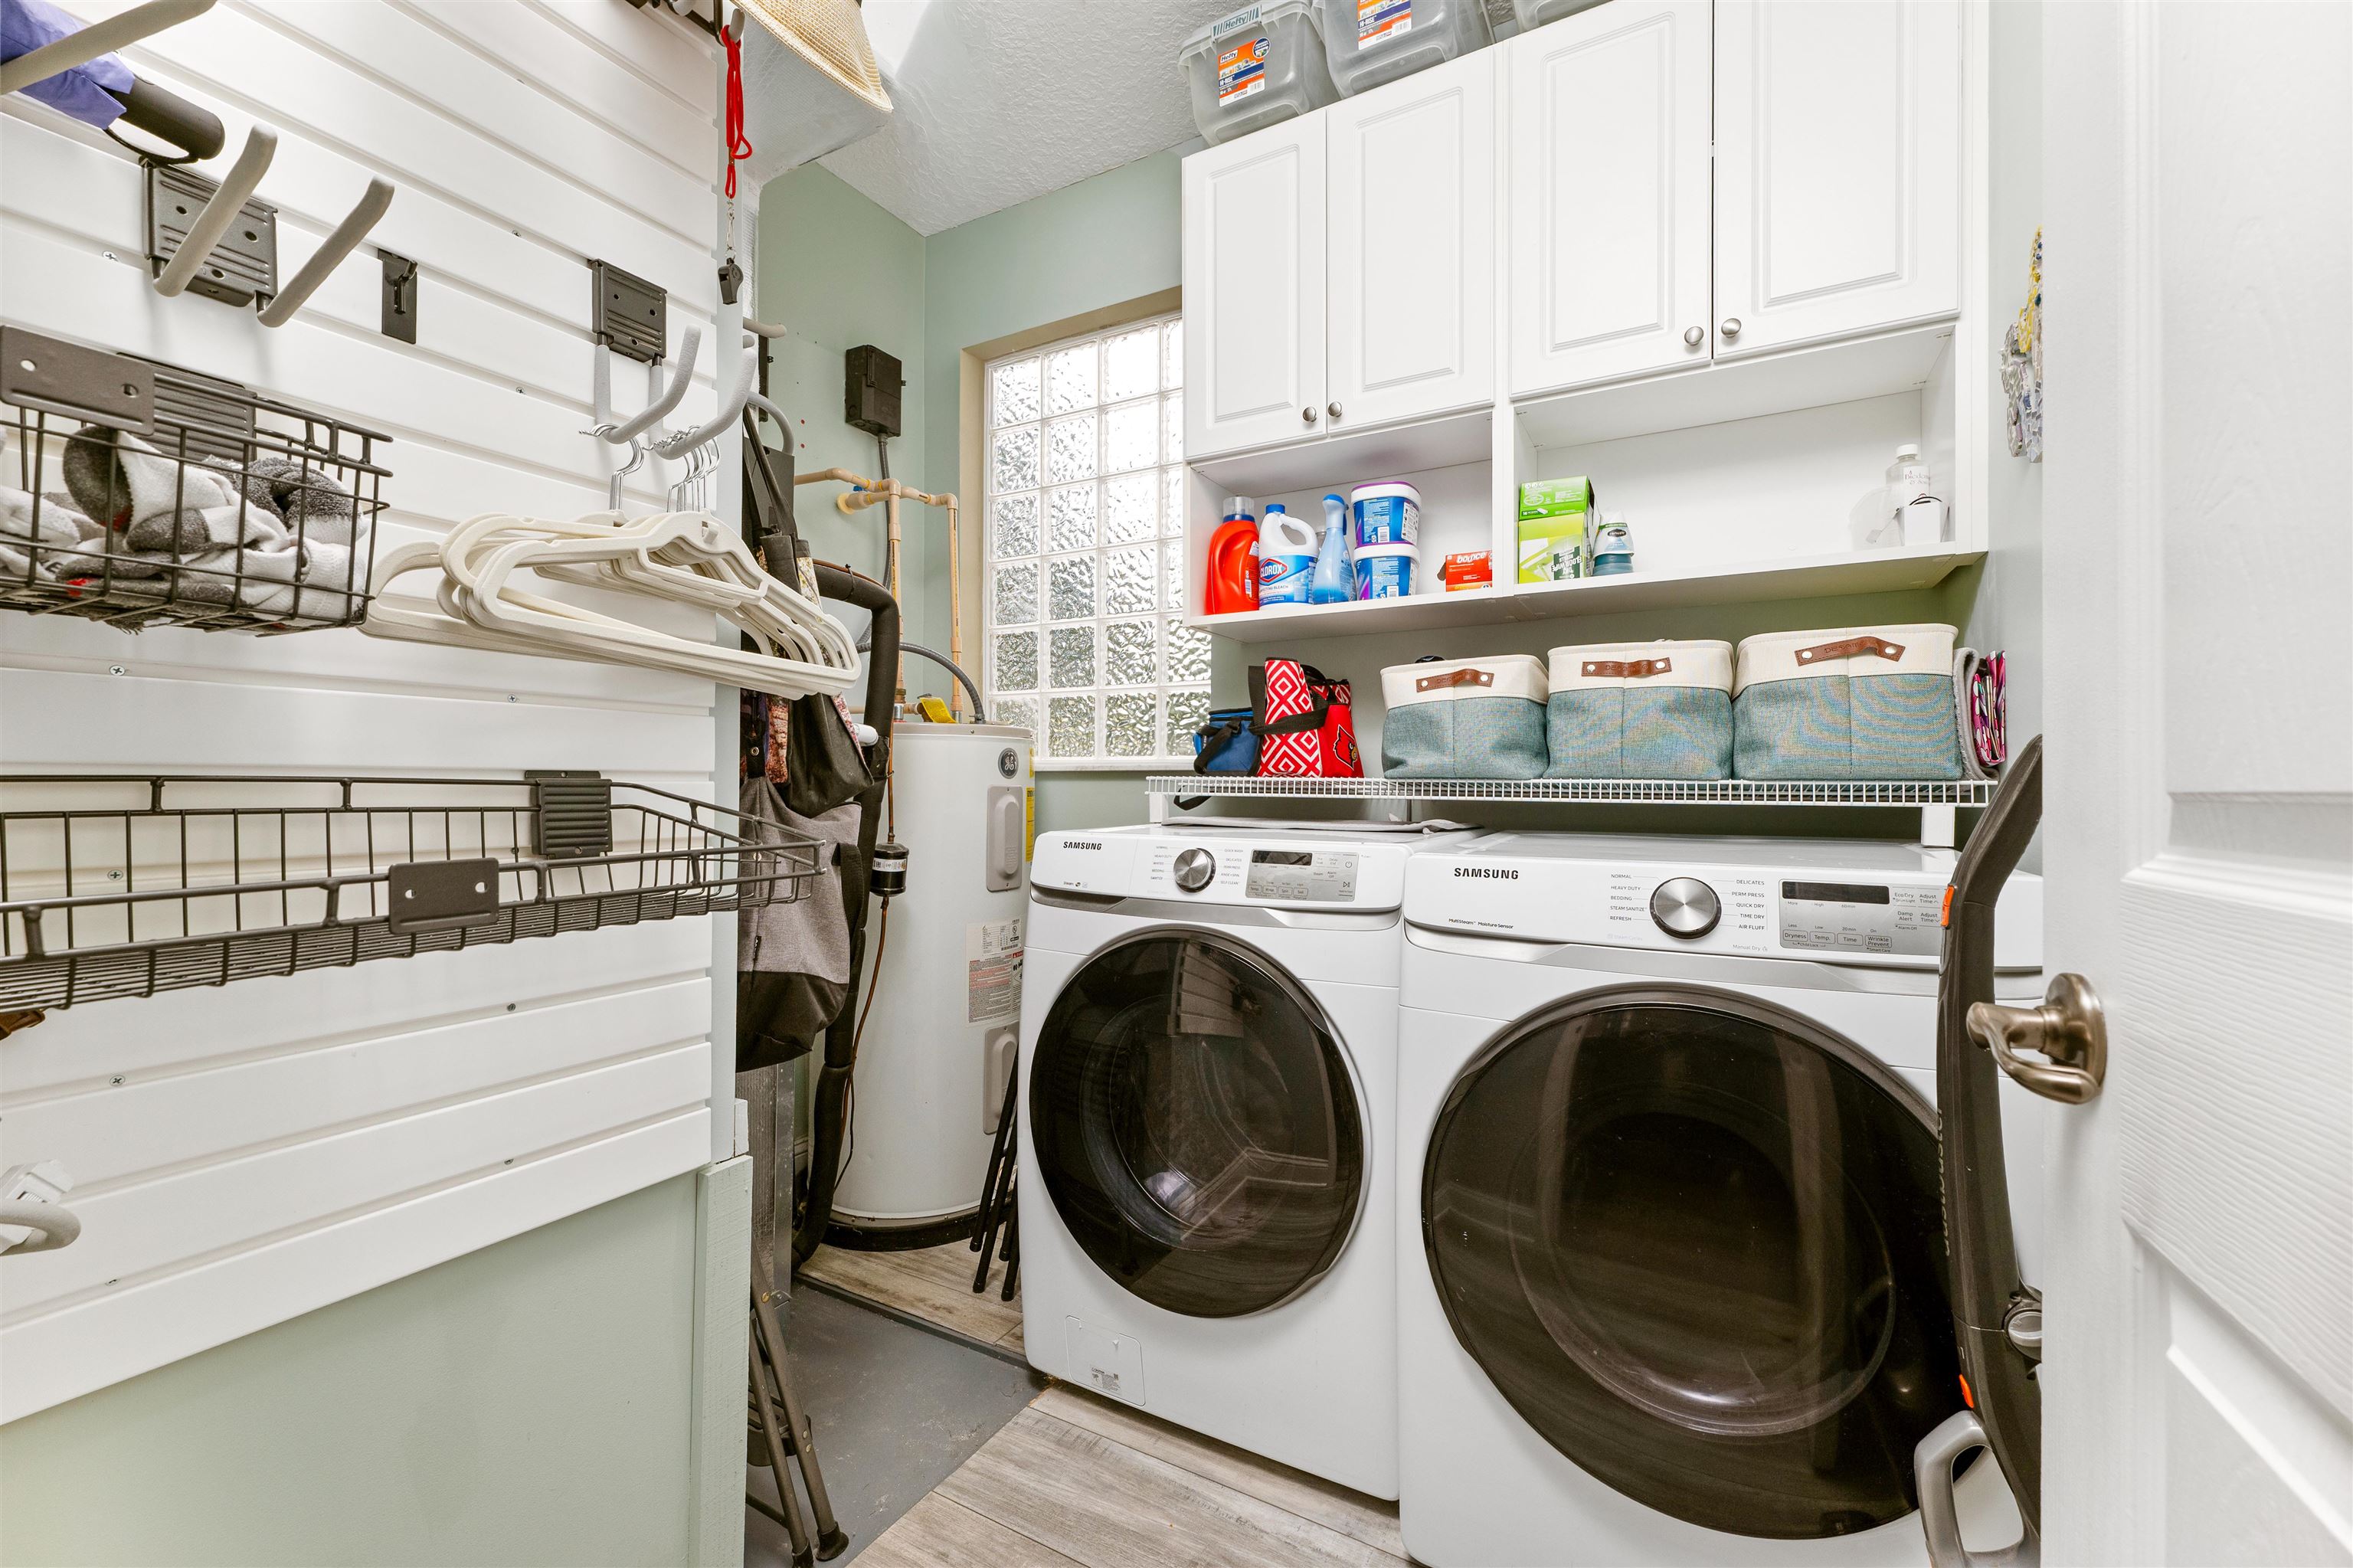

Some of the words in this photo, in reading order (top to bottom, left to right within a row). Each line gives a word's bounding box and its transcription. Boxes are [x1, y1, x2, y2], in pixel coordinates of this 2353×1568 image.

[1225, 15, 1247, 30] Hefty
[1221, 51, 1238, 61] Hefty
[1457, 552, 1486, 564] bounce
[1260, 564, 1283, 578] CLOROX
[1063, 841, 1102, 850] SAMSUNG
[1454, 867, 1519, 879] SAMSUNG
